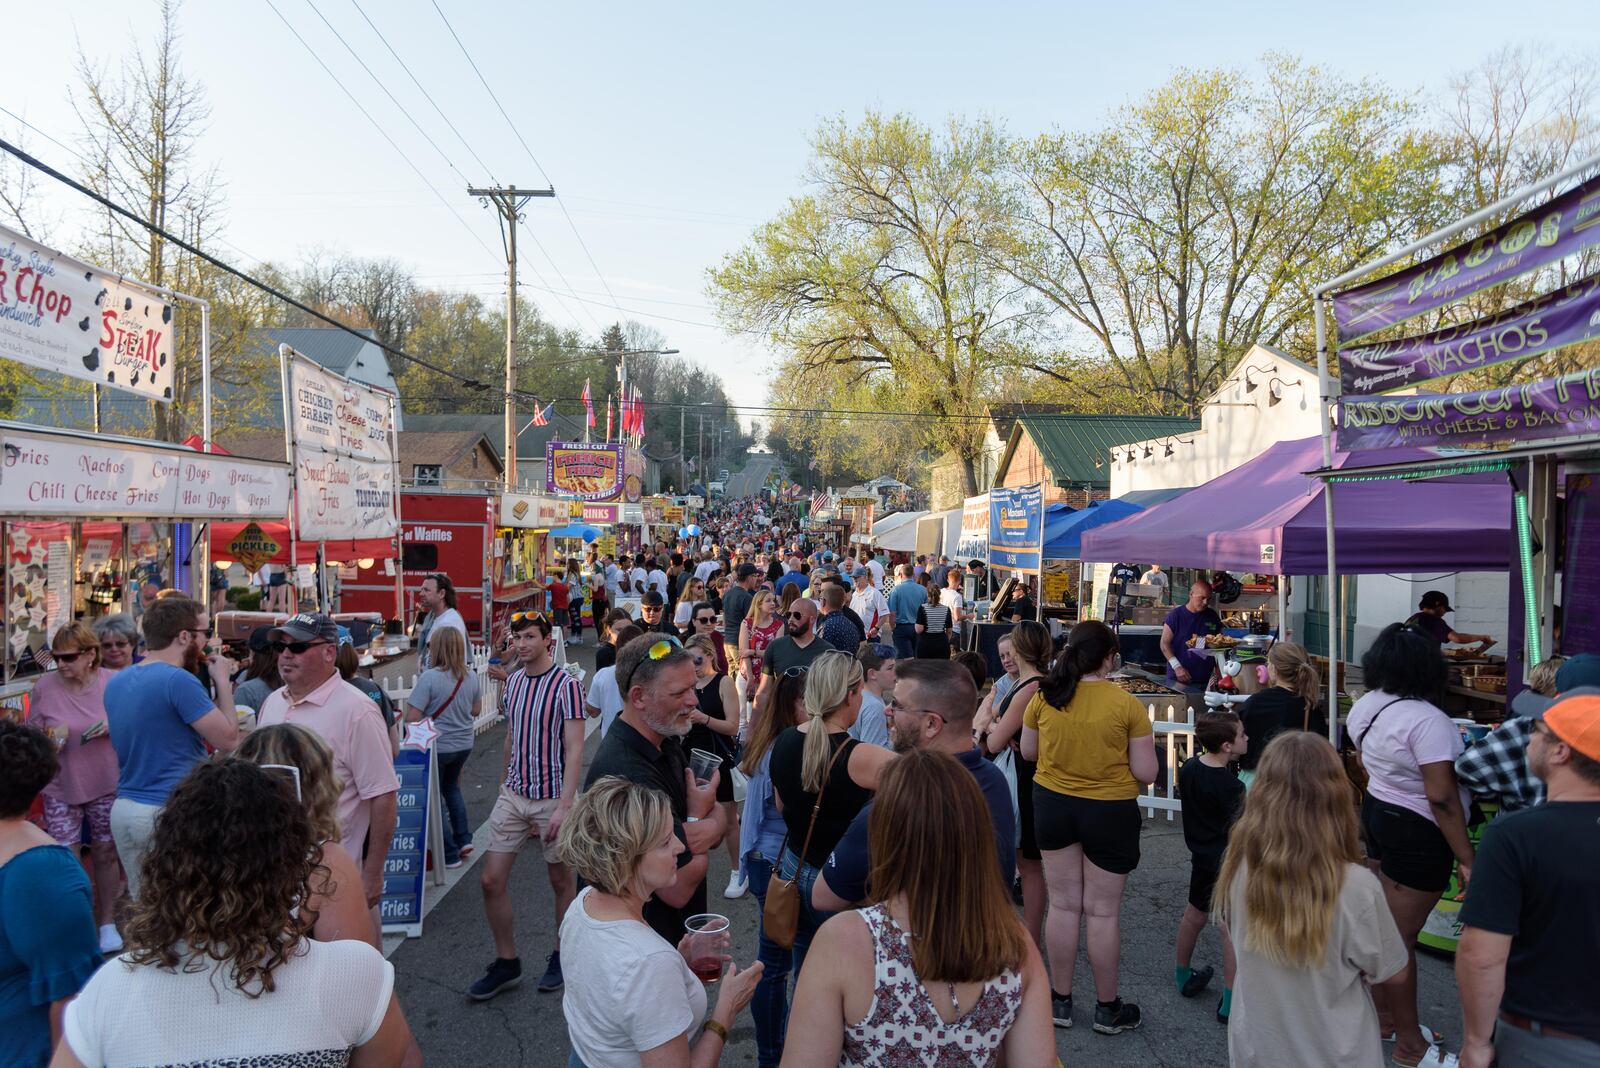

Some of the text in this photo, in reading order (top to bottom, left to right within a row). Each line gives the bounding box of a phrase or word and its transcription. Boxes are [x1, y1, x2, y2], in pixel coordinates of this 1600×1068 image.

[1408, 212, 1562, 304] TACOS
[15, 265, 72, 323] Chop
[0, 300, 42, 327] andwich
[99, 309, 162, 372] STEAK
[1424, 319, 1549, 375] NACHOS
[114, 344, 149, 378] Burger
[298, 389, 334, 410] CHICKEN
[301, 406, 333, 425] BREAST
[336, 404, 367, 427] Cheese
[1343, 397, 1447, 428] RIBBON
[1399, 425, 1432, 437] WITH
[1435, 417, 1501, 435] CHEESE
[1505, 415, 1519, 429] &
[339, 425, 363, 450] Fries
[4, 445, 49, 467] Fries
[78, 454, 125, 476] Nachos
[152, 461, 180, 478] Corn
[185, 464, 210, 485] Dogs
[303, 459, 326, 481] Sweet
[556, 452, 615, 469] FRENCH
[566, 465, 604, 478] FRIES
[29, 481, 271, 510] Chili Cheese Fries Hot Dogs Pepsi
[317, 487, 339, 516] Fries
[582, 508, 609, 519] RINKS
[414, 526, 453, 541] Waffles
[231, 542, 277, 552] PICKLES
[391, 833, 415, 850] ries
[383, 858, 410, 873] raps
[381, 899, 410, 917] Fries
